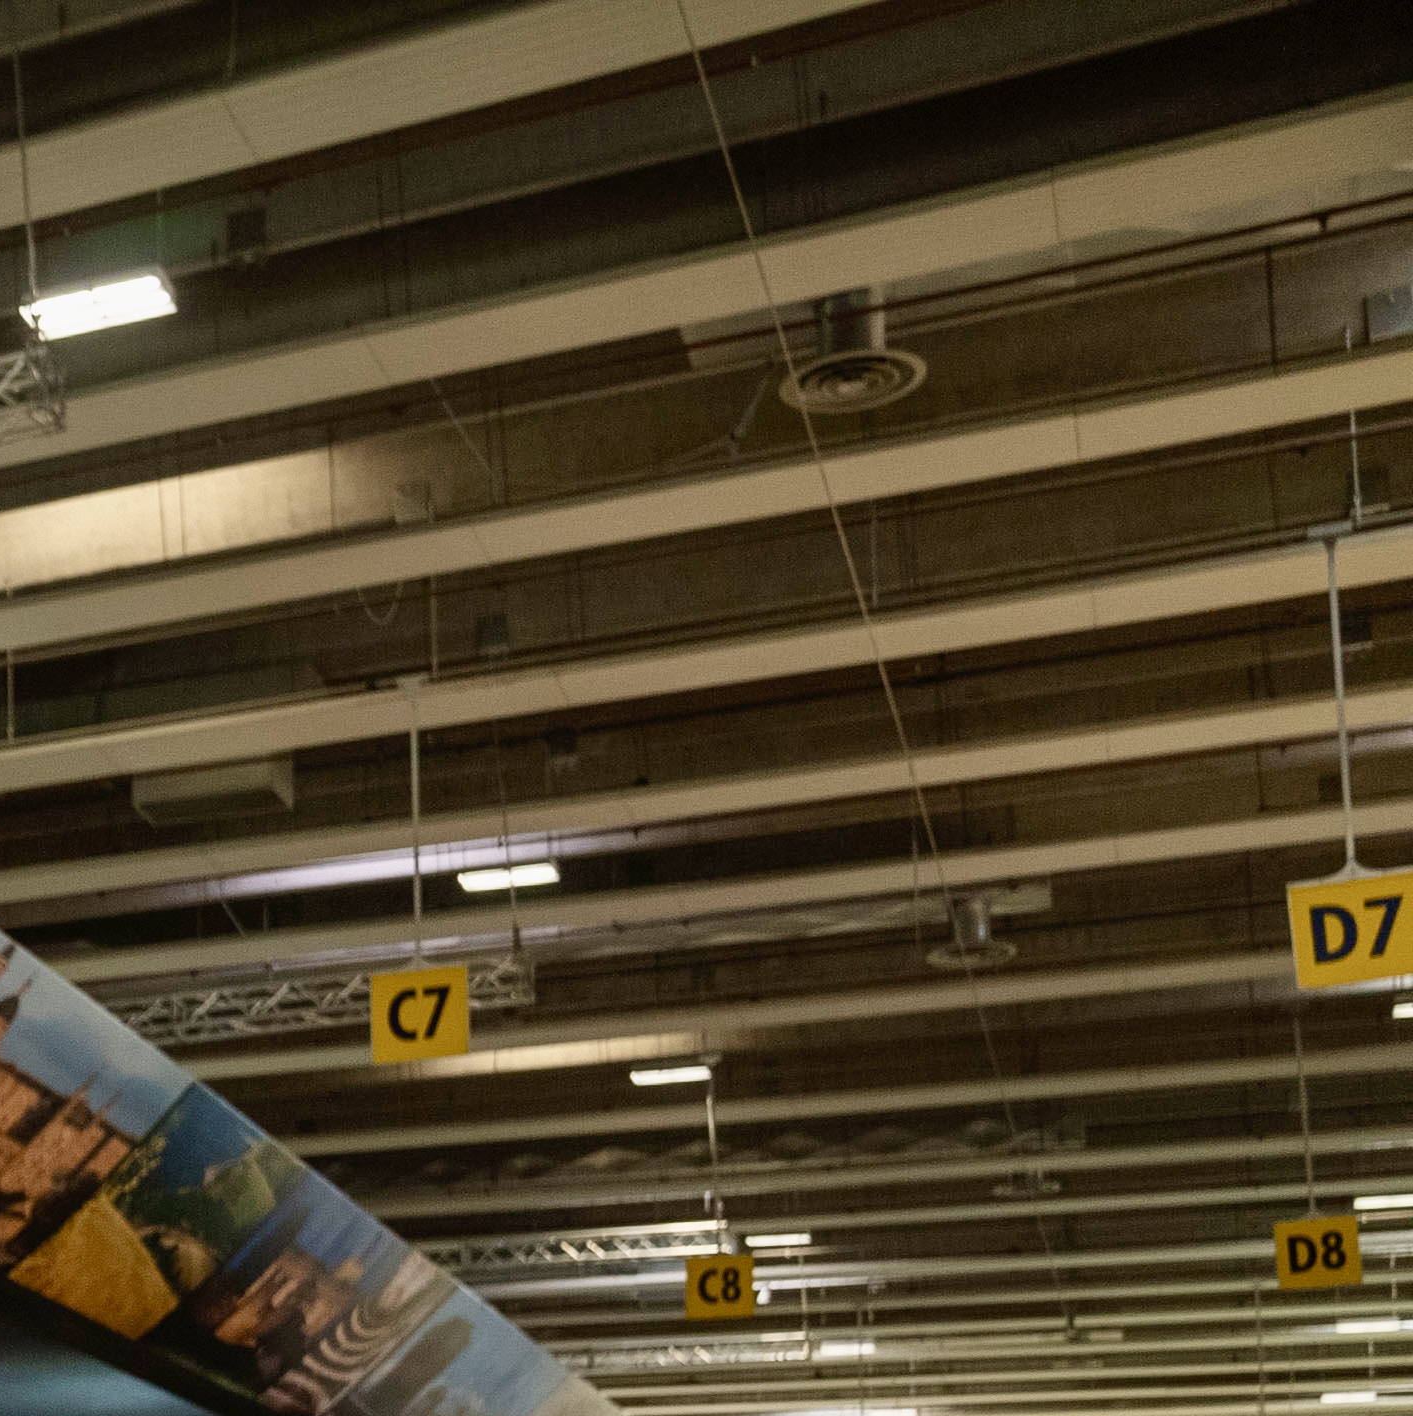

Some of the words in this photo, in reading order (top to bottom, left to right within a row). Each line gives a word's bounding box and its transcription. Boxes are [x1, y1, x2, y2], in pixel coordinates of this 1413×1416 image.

[1310, 897, 1404, 963] D7
[388, 987, 450, 1041] C7
[1287, 1233, 1346, 1274] D8
[697, 1267, 742, 1304] C8
